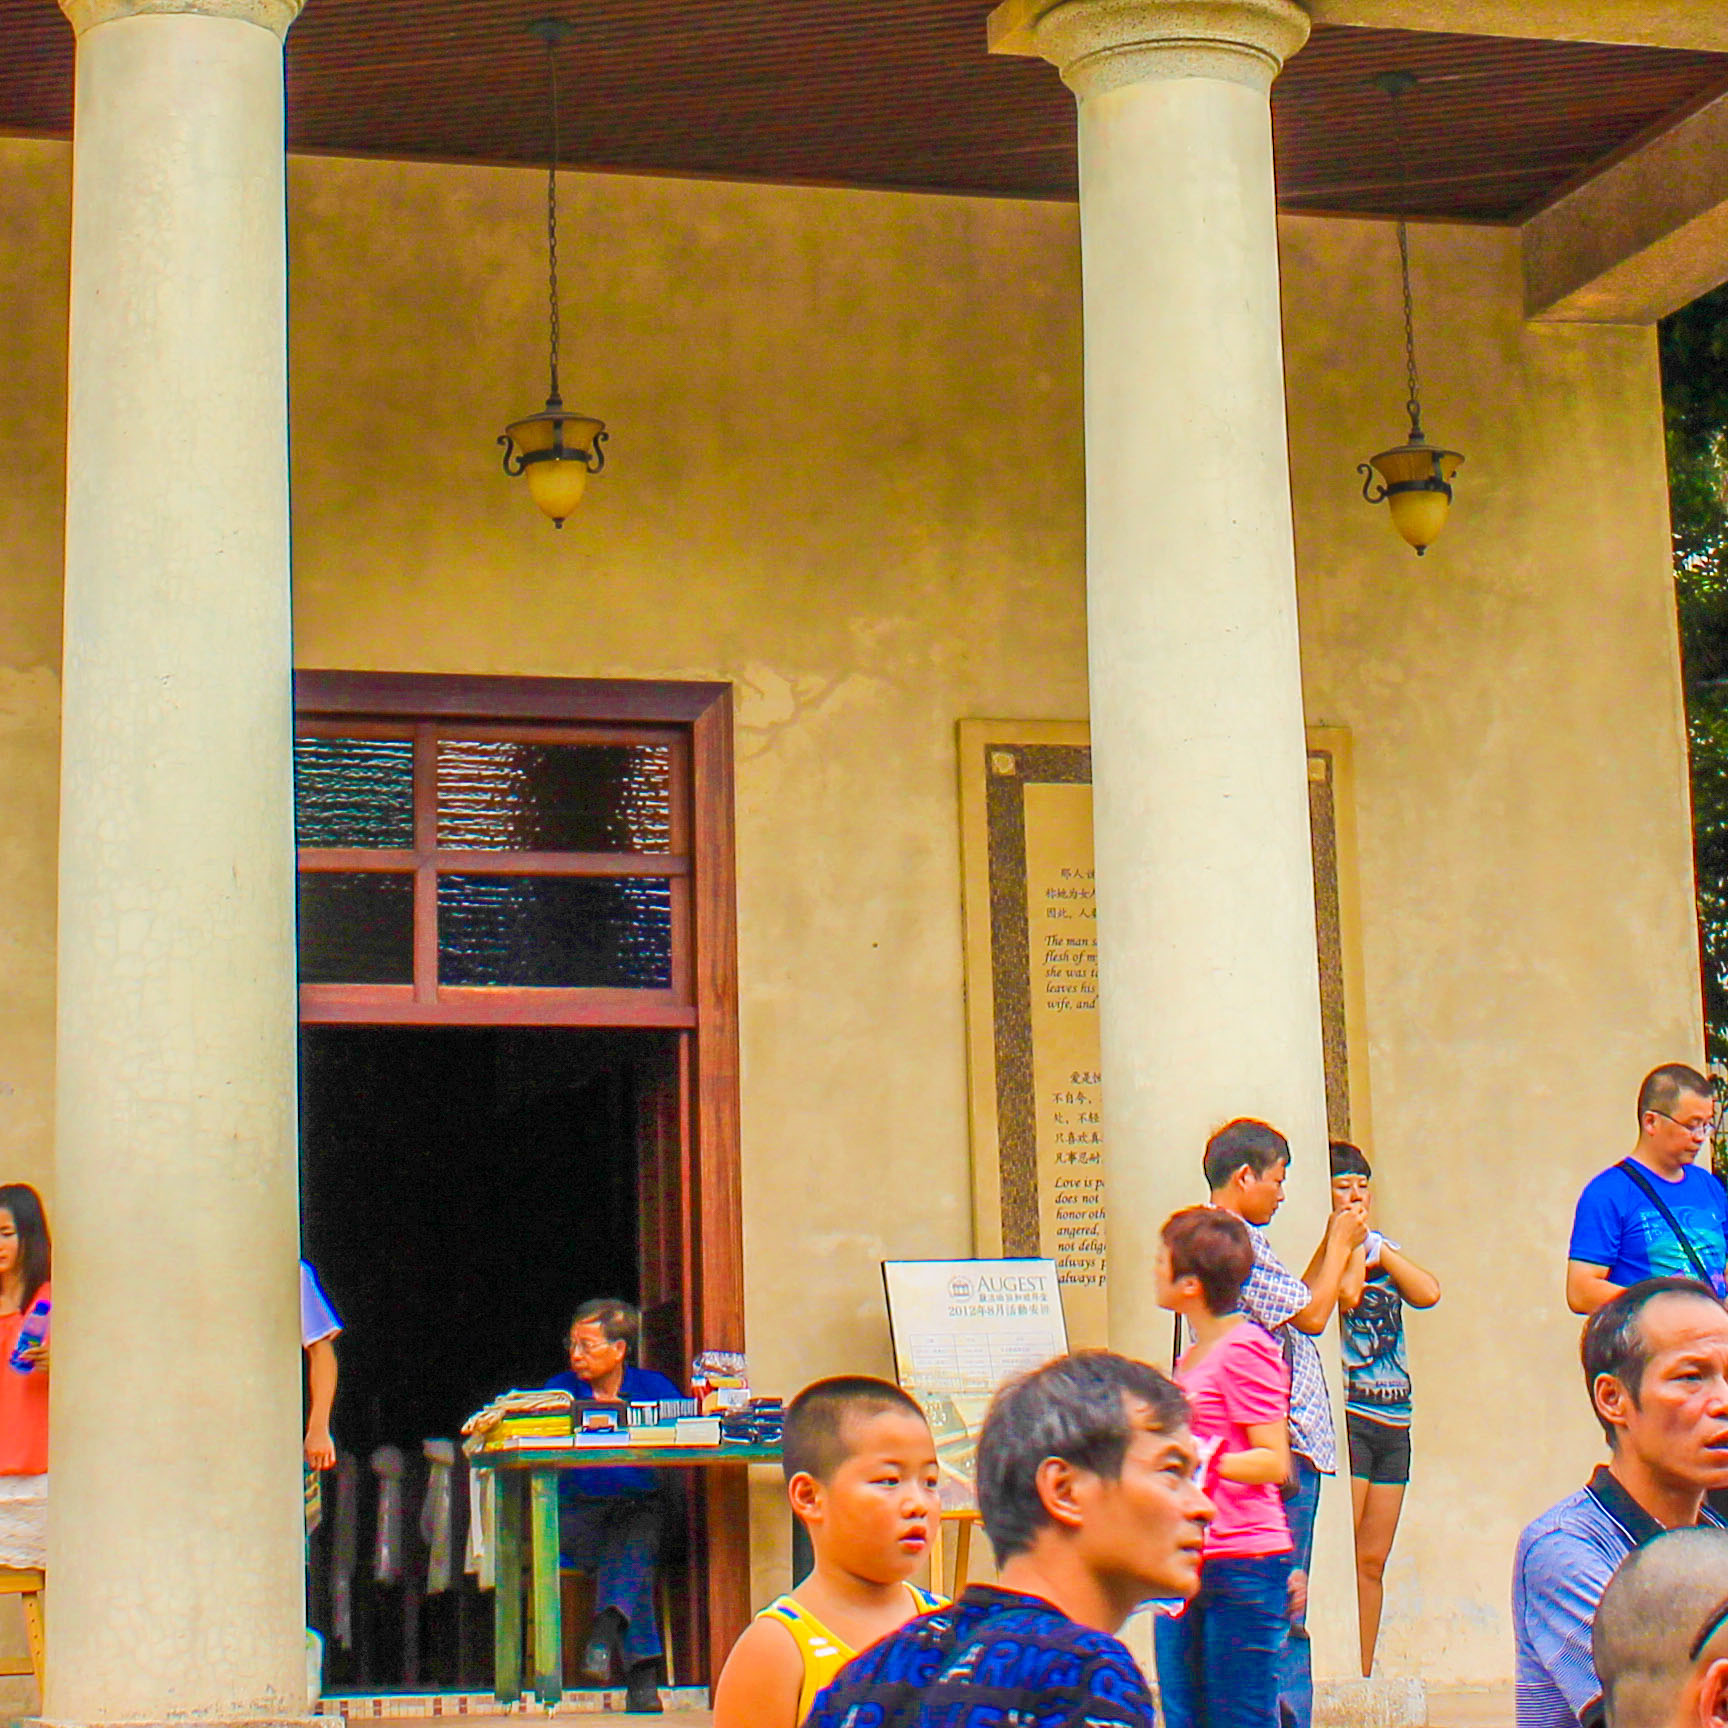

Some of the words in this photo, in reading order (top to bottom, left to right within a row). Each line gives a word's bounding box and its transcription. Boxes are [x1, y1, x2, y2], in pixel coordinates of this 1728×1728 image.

[1044, 934, 1063, 946] The
[1066, 938, 1088, 946] man
[1042, 949, 1069, 966] flesh
[1073, 950, 1086, 965] of
[1045, 966, 1061, 978] she
[1066, 969, 1086, 978] was
[1046, 981, 1077, 992] leaves
[1080, 981, 1095, 992] his
[1047, 996, 1072, 1012] wife,
[1076, 994, 1098, 1008] and
[1055, 1176, 1080, 1188] Love
[1084, 1176, 1092, 1187] is
[1055, 1192, 1077, 1204] does
[1082, 1195, 1098, 1203] not
[1056, 1207, 1086, 1220] honor
[1088, 1207, 1105, 1220] oth
[1056, 1223, 1099, 1238] angered,
[1058, 1242, 1074, 1251] not
[1058, 1255, 1095, 1271] always
[978, 1275, 1046, 1292] AUGEST
[1058, 1271, 1095, 1287] always
